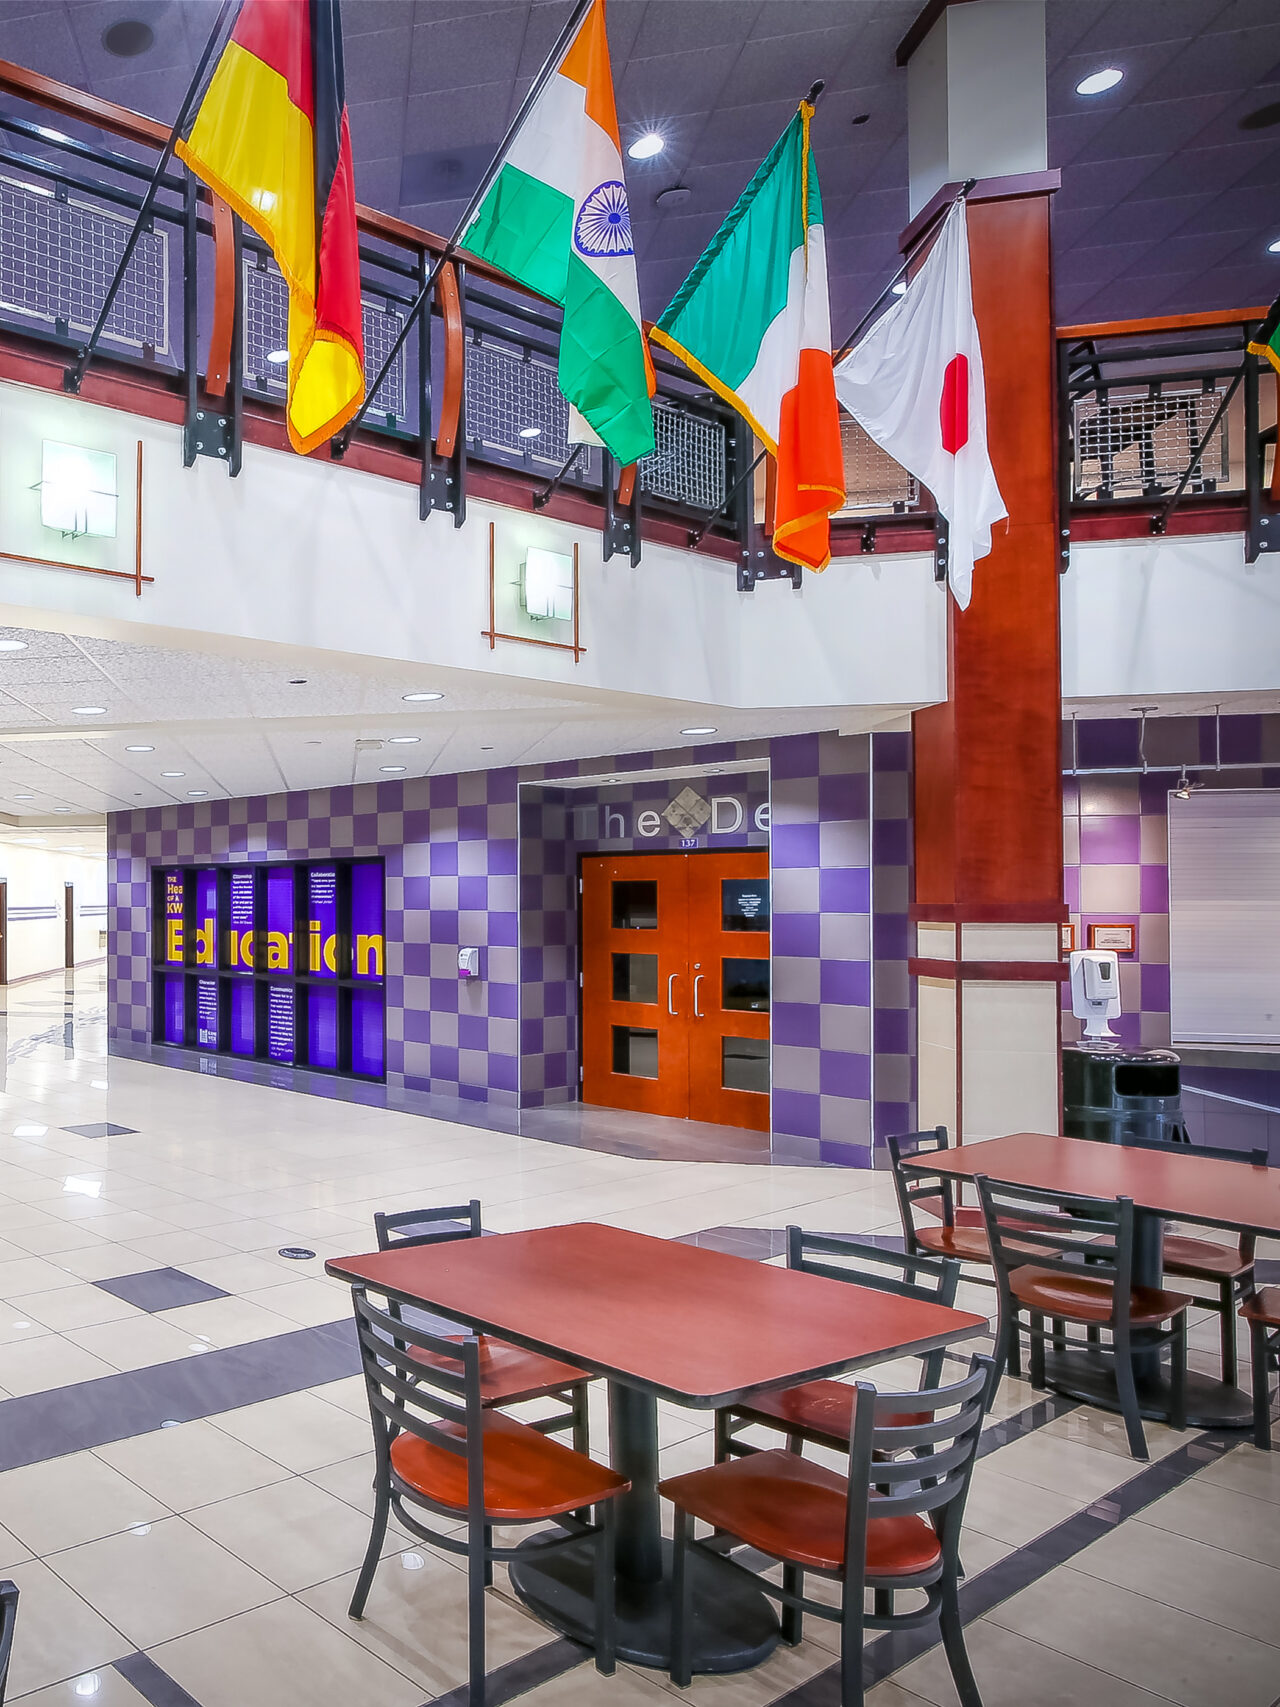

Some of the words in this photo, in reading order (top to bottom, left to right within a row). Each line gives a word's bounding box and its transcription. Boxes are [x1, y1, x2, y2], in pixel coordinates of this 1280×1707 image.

[681, 839, 696, 847] 137
[167, 884, 183, 894] Hea
[167, 903, 183, 914] KW
[167, 918, 383, 975] Edcaion
